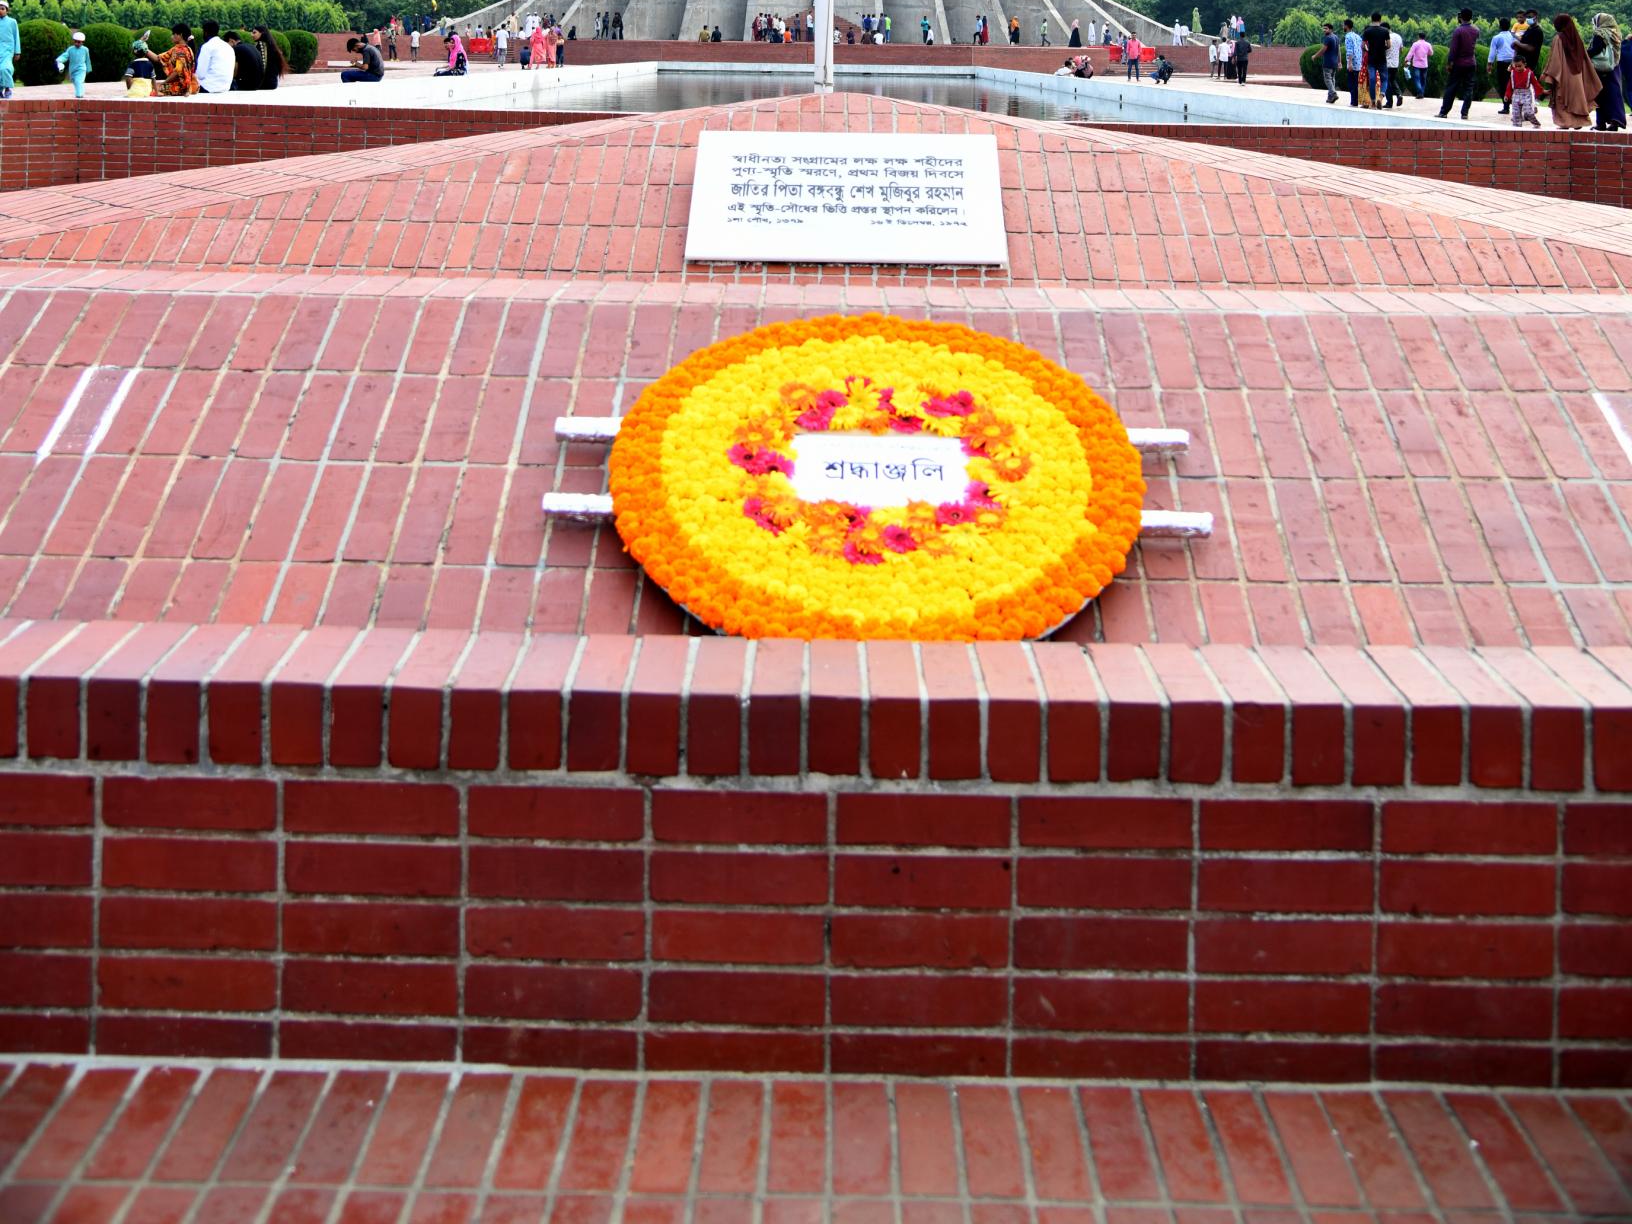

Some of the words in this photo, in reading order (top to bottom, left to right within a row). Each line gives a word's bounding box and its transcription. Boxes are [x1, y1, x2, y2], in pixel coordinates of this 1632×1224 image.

[730, 153, 786, 164] স্বাধীনতা
[792, 155, 848, 166] সংগ্রামের
[853, 156, 878, 166] লক্ষ
[883, 157, 908, 167] লক্ষ
[914, 156, 963, 167] শহীদের
[847, 168, 879, 178] প্রথম
[884, 166, 919, 179] বিজয়
[925, 167, 964, 179] দিবসে
[730, 179, 769, 197] জাতির
[774, 179, 802, 197] পিতা
[807, 184, 845, 203] বঙ্গবন্ধু
[850, 184, 875, 199] শেখ
[879, 181, 920, 203] মুজিবুর
[925, 185, 964, 201] রহমান
[728, 201, 745, 212] এই
[824, 457, 944, 482] শ্রদ্ধাঞ্জলি
